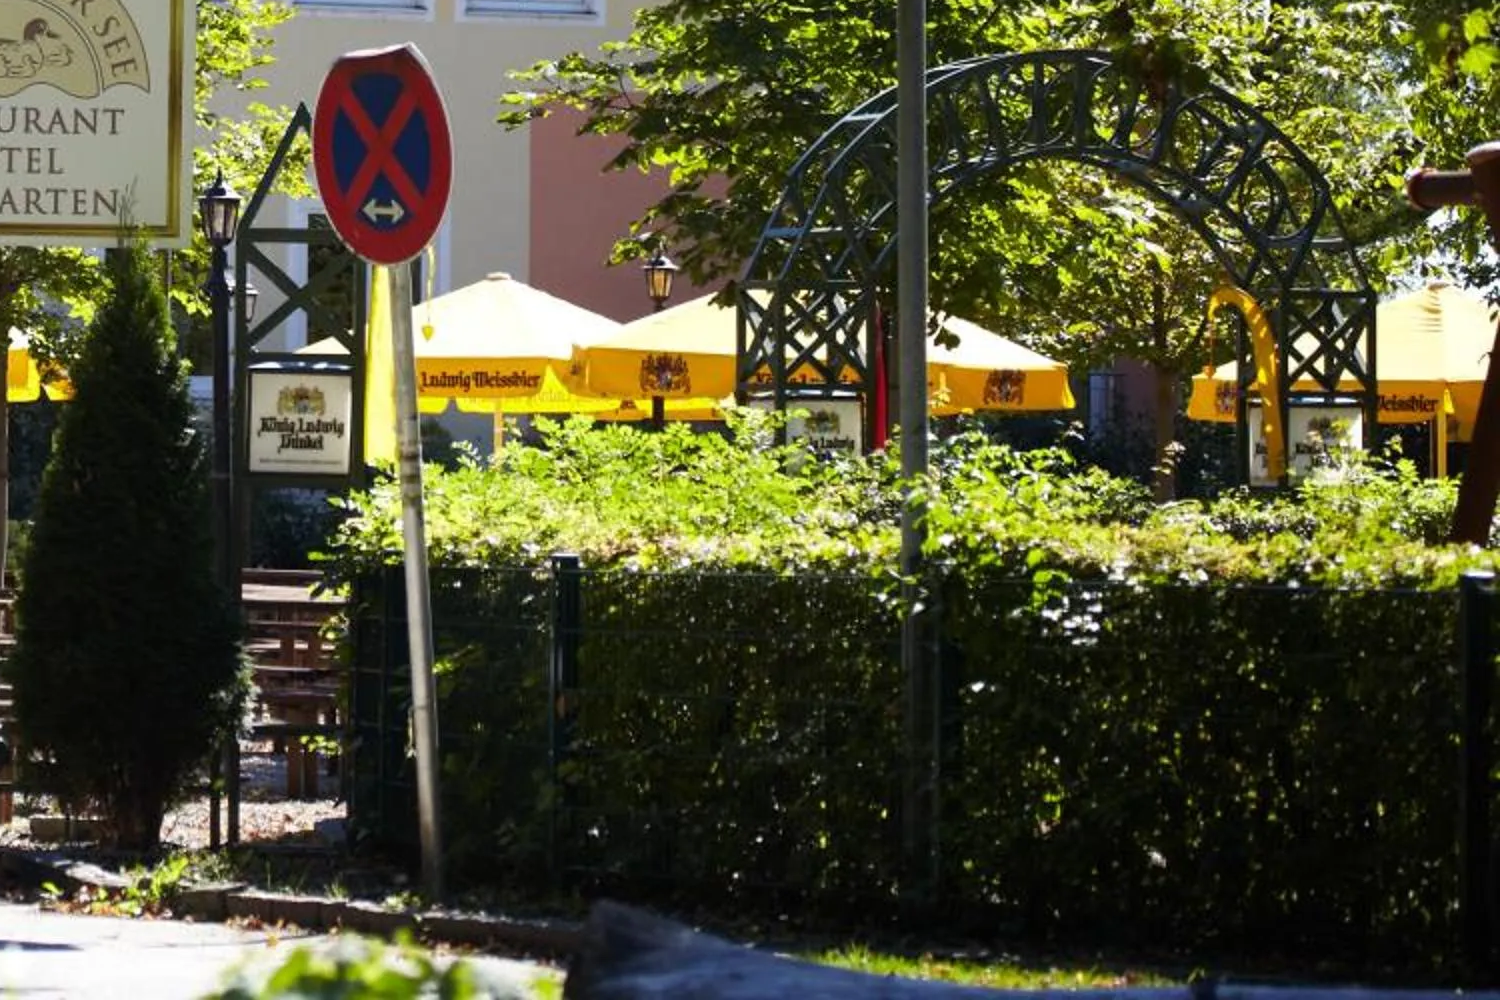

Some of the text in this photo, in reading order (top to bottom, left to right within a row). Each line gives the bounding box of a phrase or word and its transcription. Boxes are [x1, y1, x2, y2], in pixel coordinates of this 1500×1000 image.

[92, 15, 139, 78] SEE
[420, 370, 541, 392] Ludwig Weissbier
[257, 416, 345, 438] König Ludwig
[277, 433, 324, 454] Dunkel
